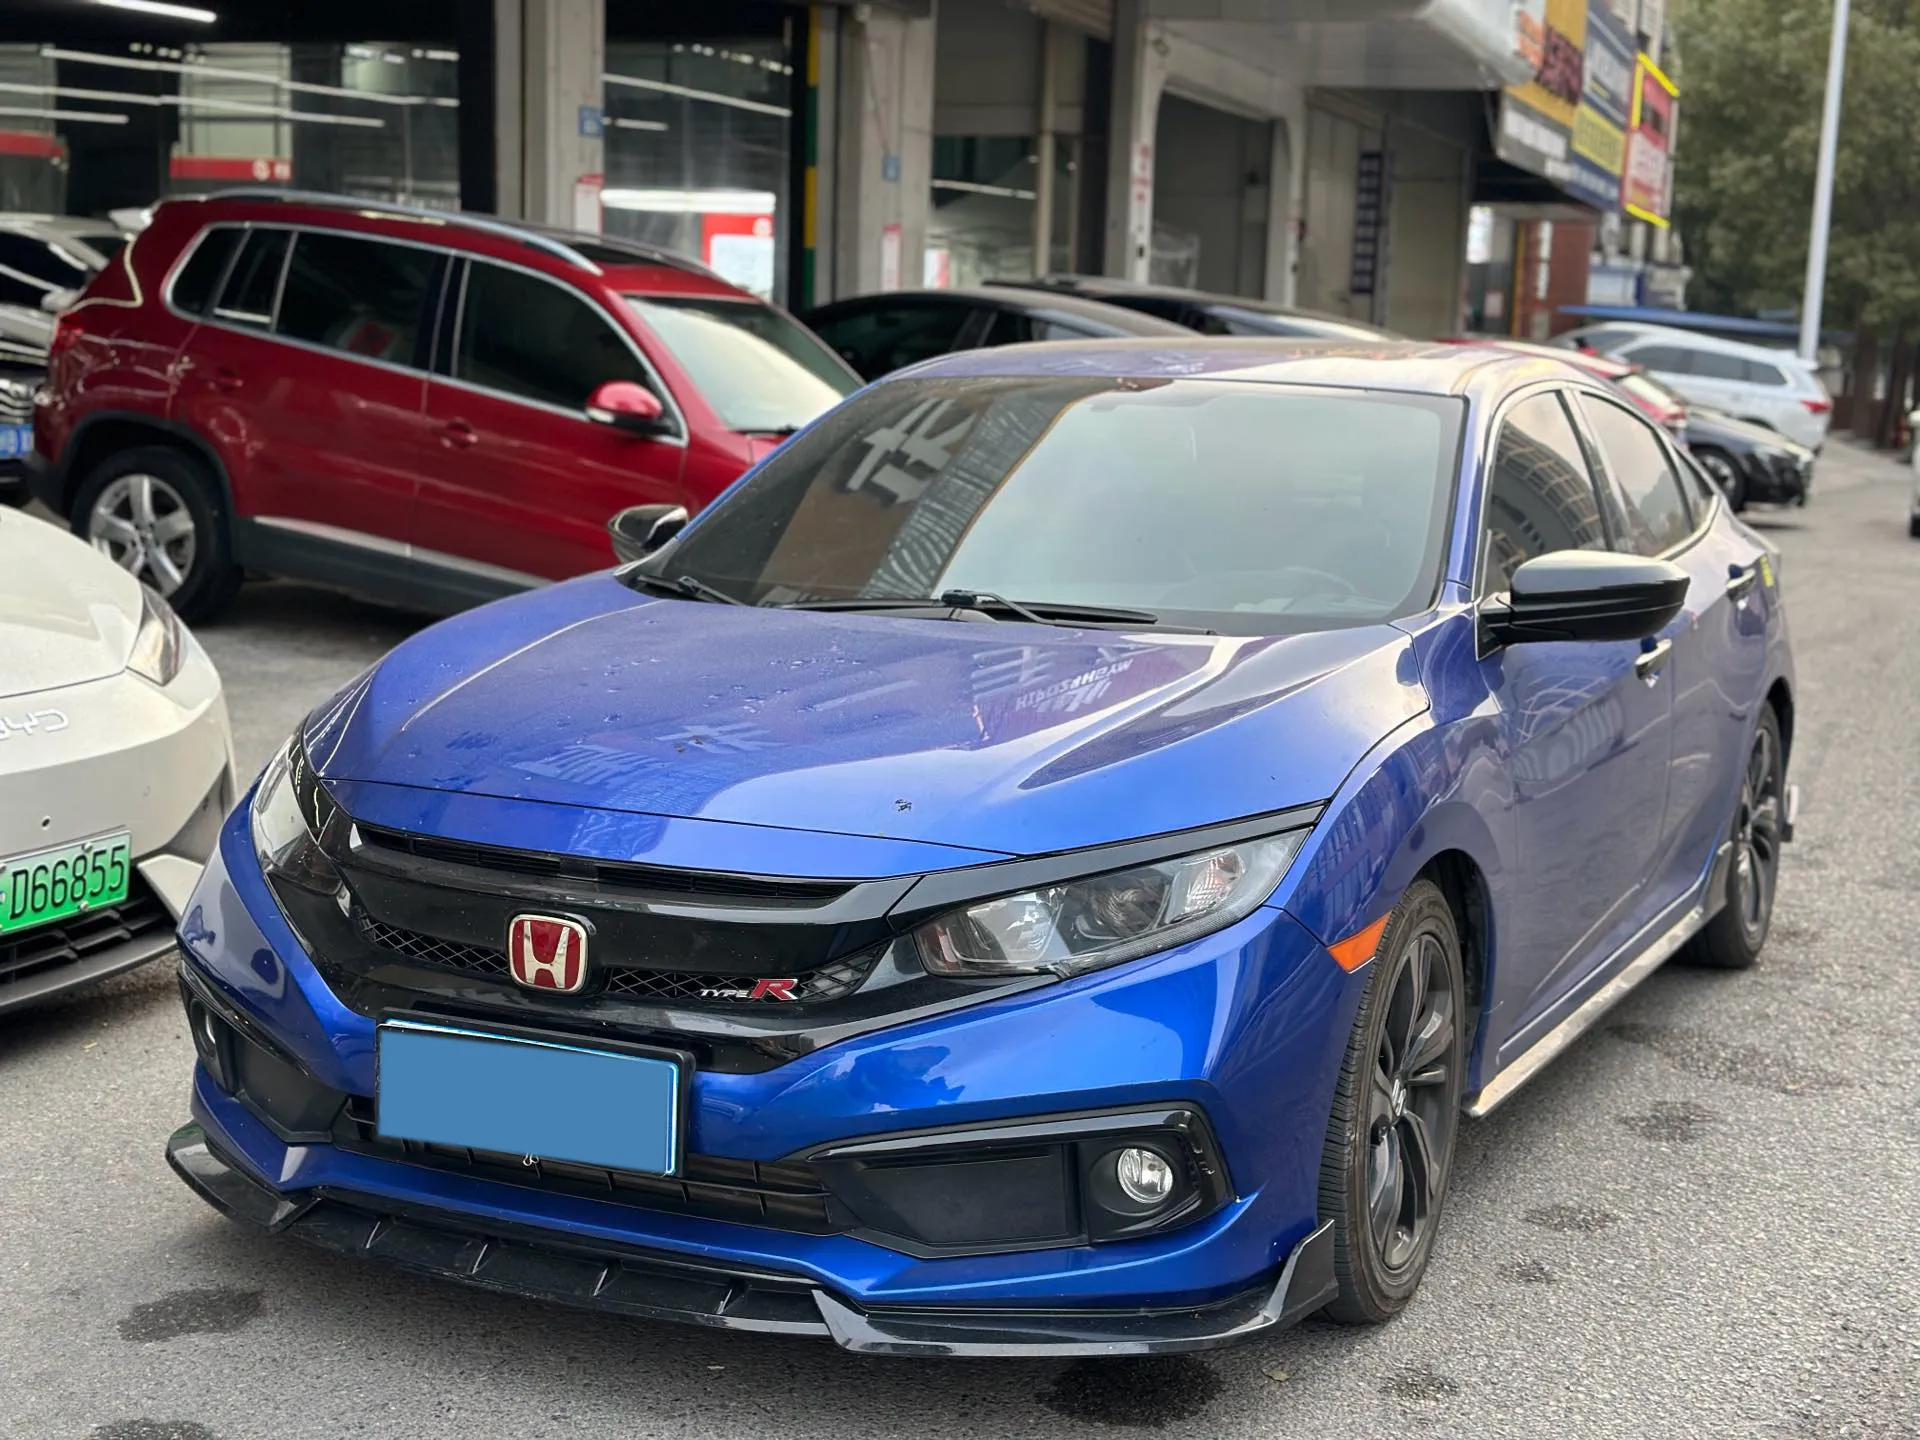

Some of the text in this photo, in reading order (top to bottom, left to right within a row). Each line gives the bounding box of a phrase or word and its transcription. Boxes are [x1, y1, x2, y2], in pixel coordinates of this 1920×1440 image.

[0, 709, 69, 741] YD
[10, 844, 126, 920] D66855
[700, 978, 799, 1001] TYPE R
